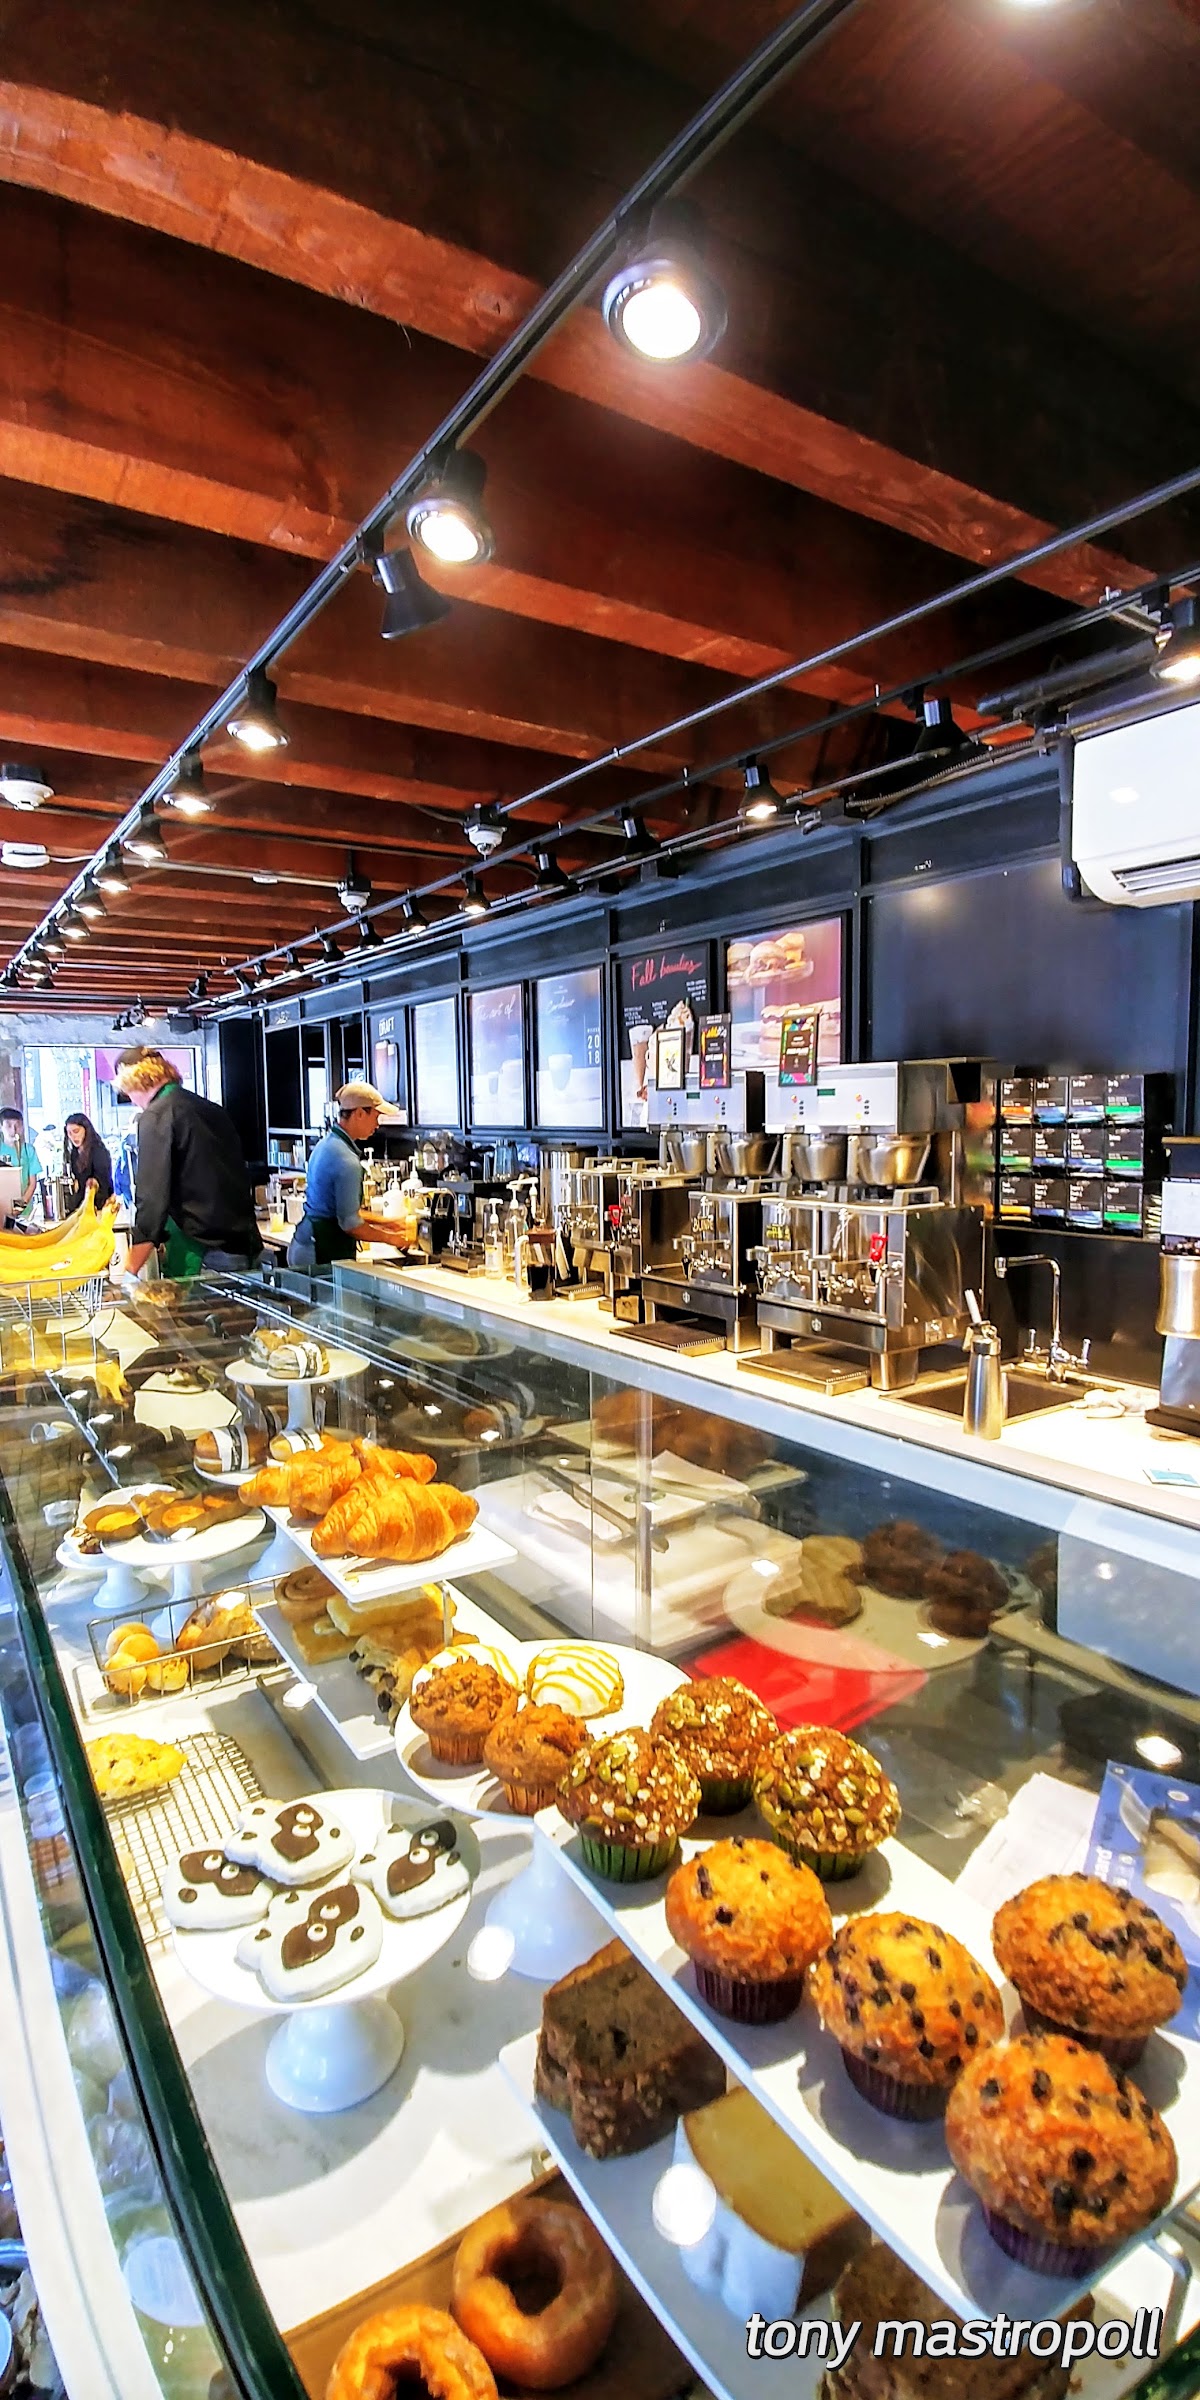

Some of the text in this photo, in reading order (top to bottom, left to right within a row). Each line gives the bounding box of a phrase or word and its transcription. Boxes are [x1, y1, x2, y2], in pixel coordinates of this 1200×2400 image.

[632, 958, 657, 992] Fall
[587, 1034, 600, 1049] 20
[588, 1050, 600, 1066] 18
